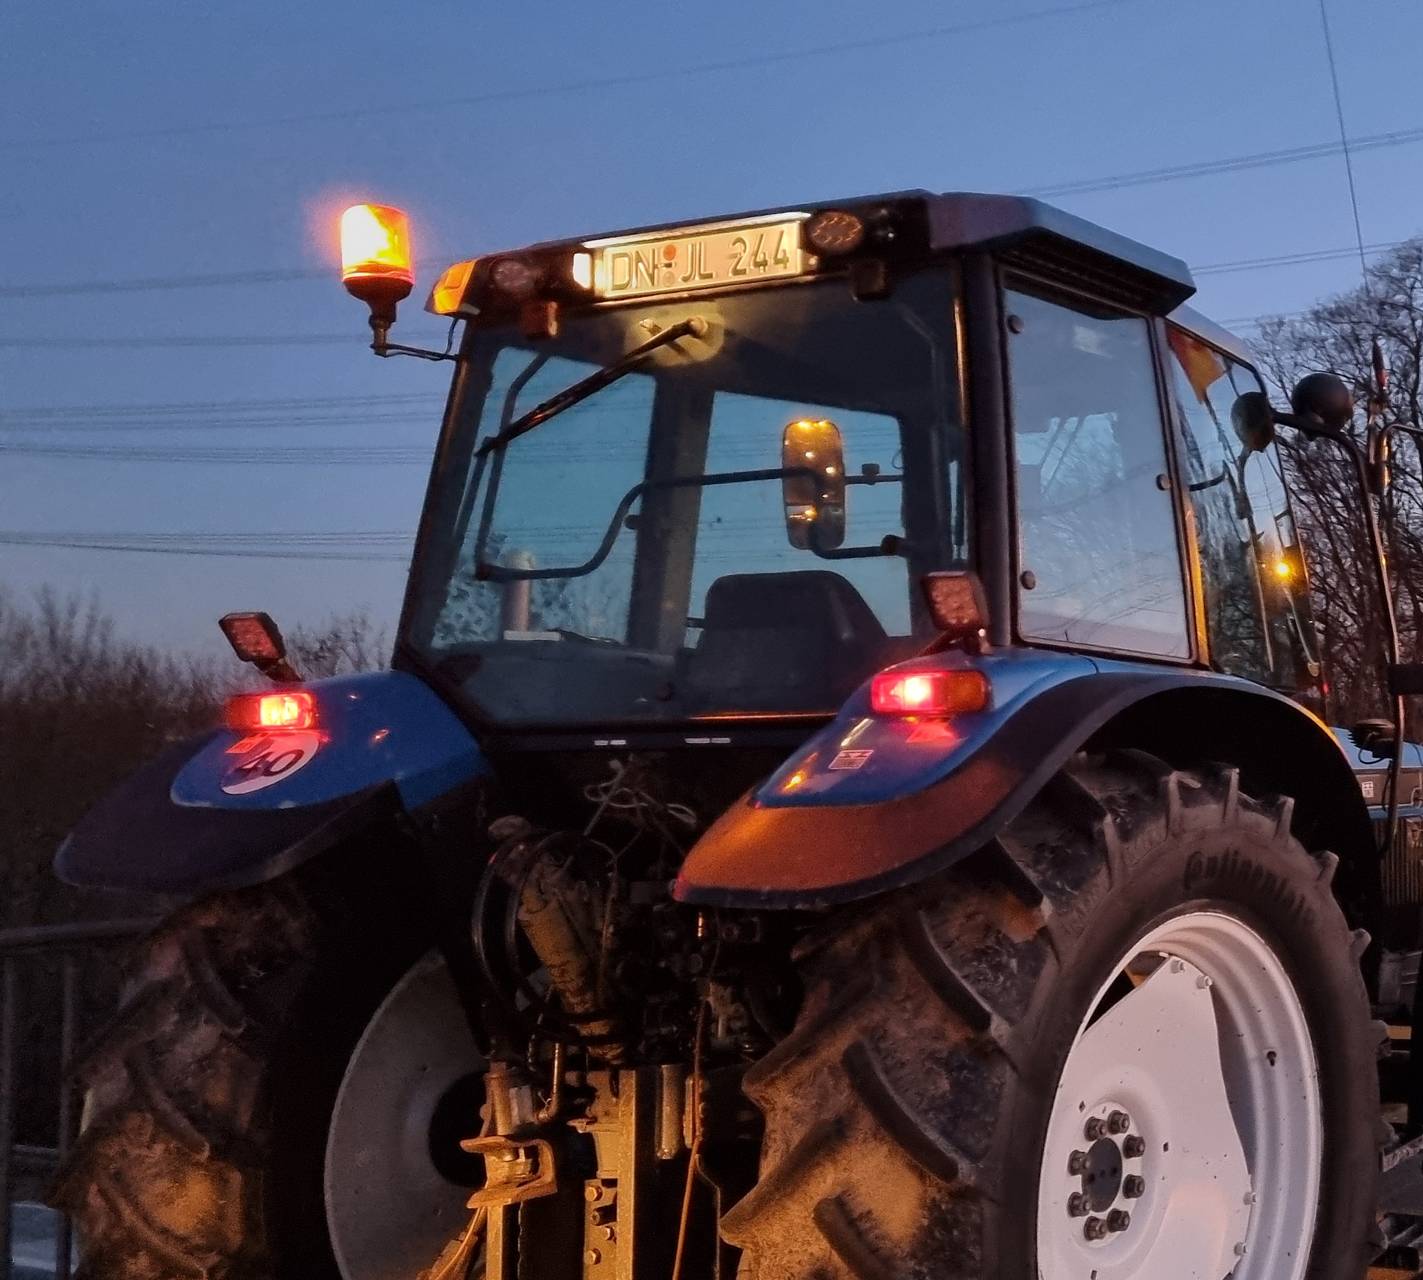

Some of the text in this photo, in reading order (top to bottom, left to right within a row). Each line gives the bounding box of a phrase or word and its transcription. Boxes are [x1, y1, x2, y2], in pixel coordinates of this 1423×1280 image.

[612, 230, 790, 291] DN JL 244
[234, 749, 305, 777] 40
